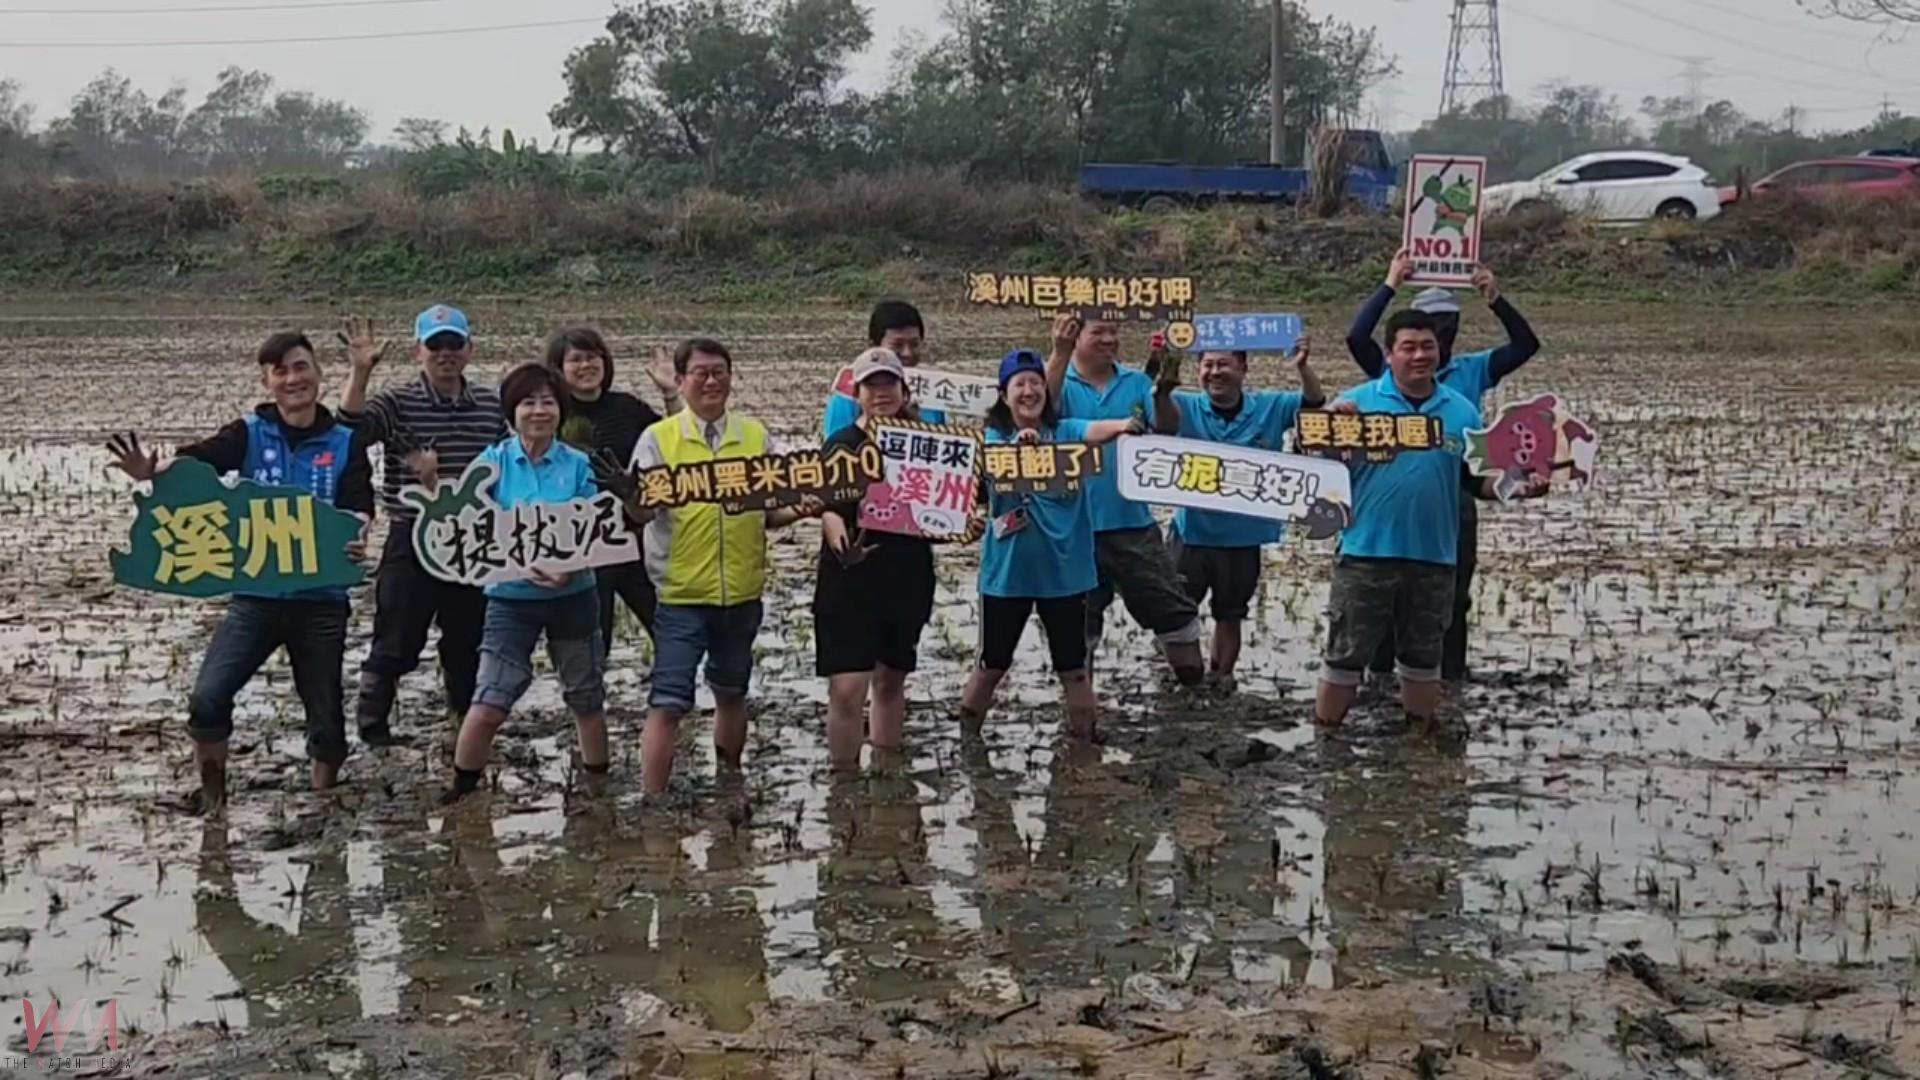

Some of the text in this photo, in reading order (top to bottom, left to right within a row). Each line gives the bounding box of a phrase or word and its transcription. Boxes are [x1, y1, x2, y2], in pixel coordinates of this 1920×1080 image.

[1413, 236, 1470, 259] NO.1
[968, 271, 1192, 308] 溪州芭樂尚好呷
[879, 430, 971, 468] 逗陣來
[637, 444, 881, 506] 溪州黑米尚介Q
[893, 463, 973, 514] 溪州
[1133, 448, 1320, 505] 有泥真好!
[152, 495, 318, 585] 溪州
